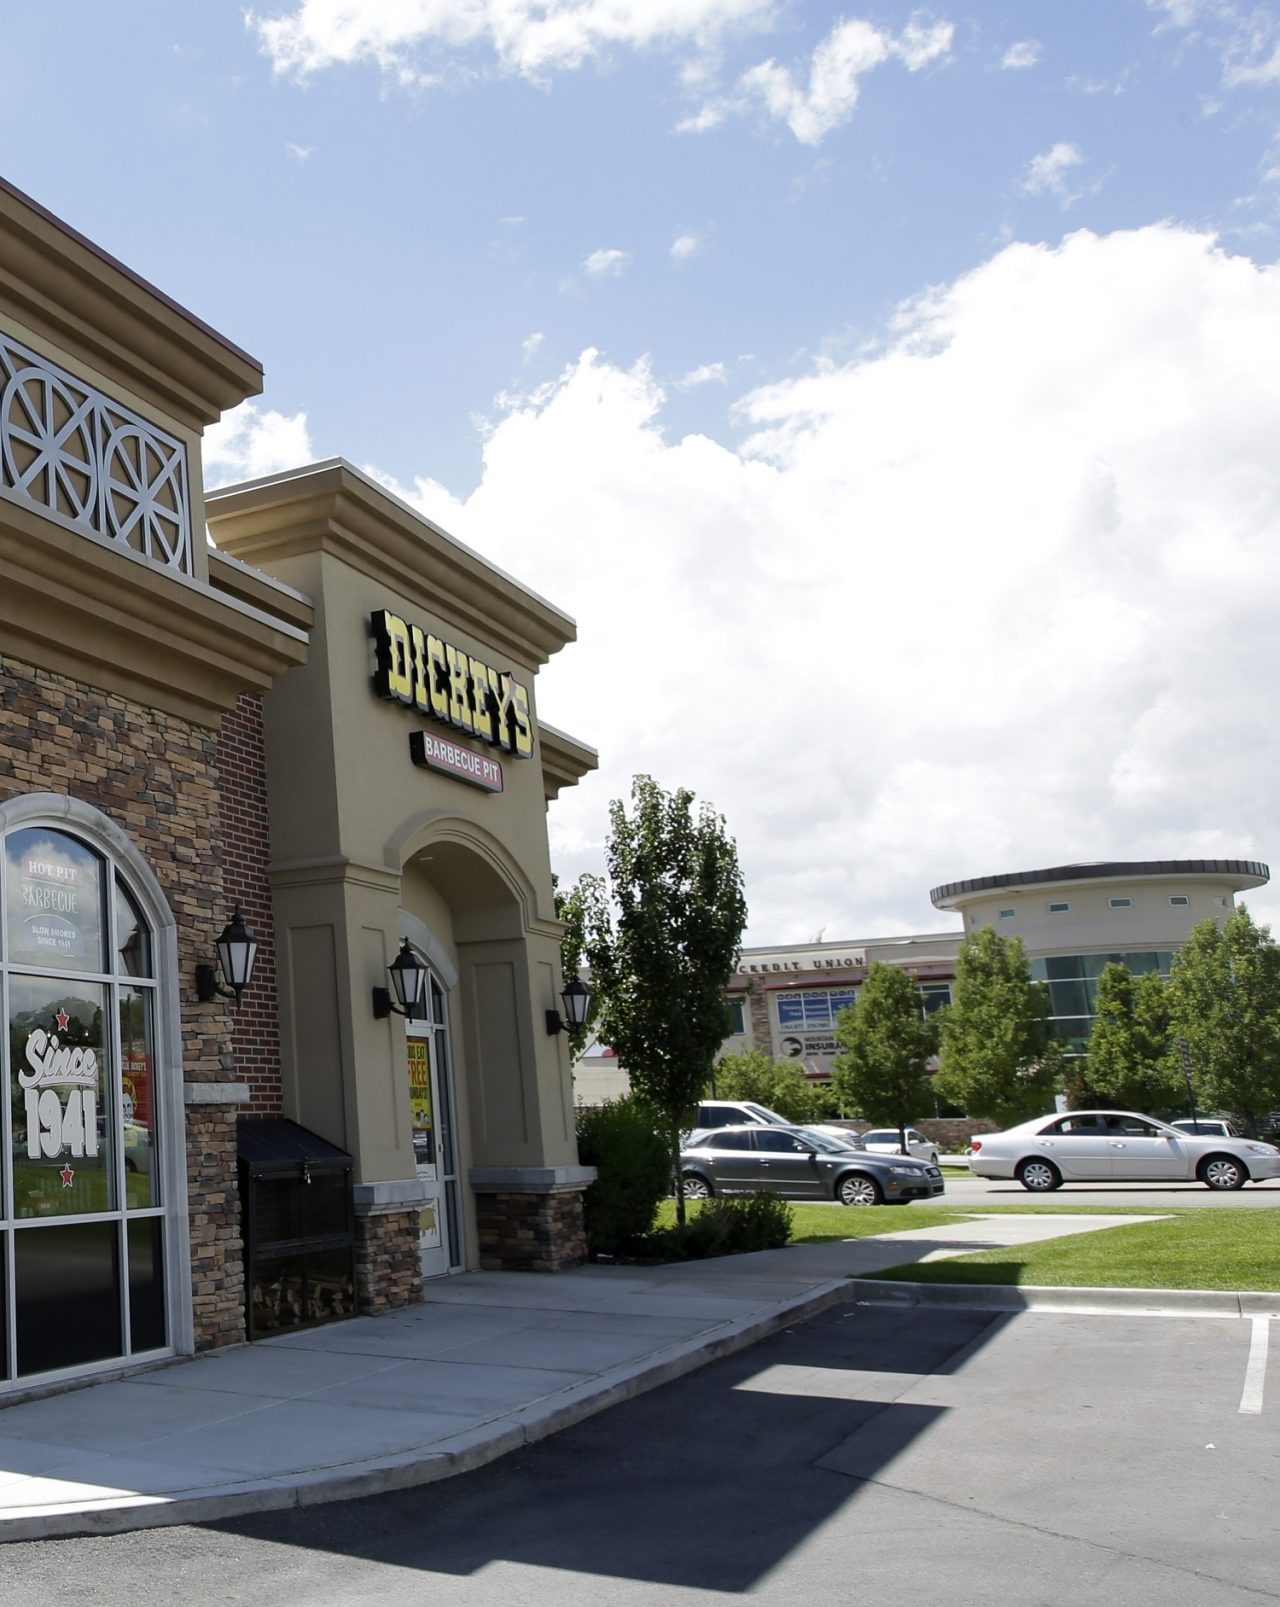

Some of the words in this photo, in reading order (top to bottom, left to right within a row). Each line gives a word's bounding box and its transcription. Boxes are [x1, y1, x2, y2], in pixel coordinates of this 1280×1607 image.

[424, 736, 481, 776] BARBECUE
[483, 761, 499, 783] PIT
[28, 860, 54, 878] HOT
[55, 866, 77, 881] PIT
[21, 883, 79, 914] BARBECUE
[31, 925, 50, 935] SLOW
[50, 928, 76, 939] SMOKED
[37, 937, 57, 946] SINCE
[58, 939, 71, 949] 1941
[738, 961, 800, 974] CREDIT
[813, 956, 864, 969] UNION
[18, 1028, 98, 1089] Since
[24, 1088, 99, 1159] 1941
